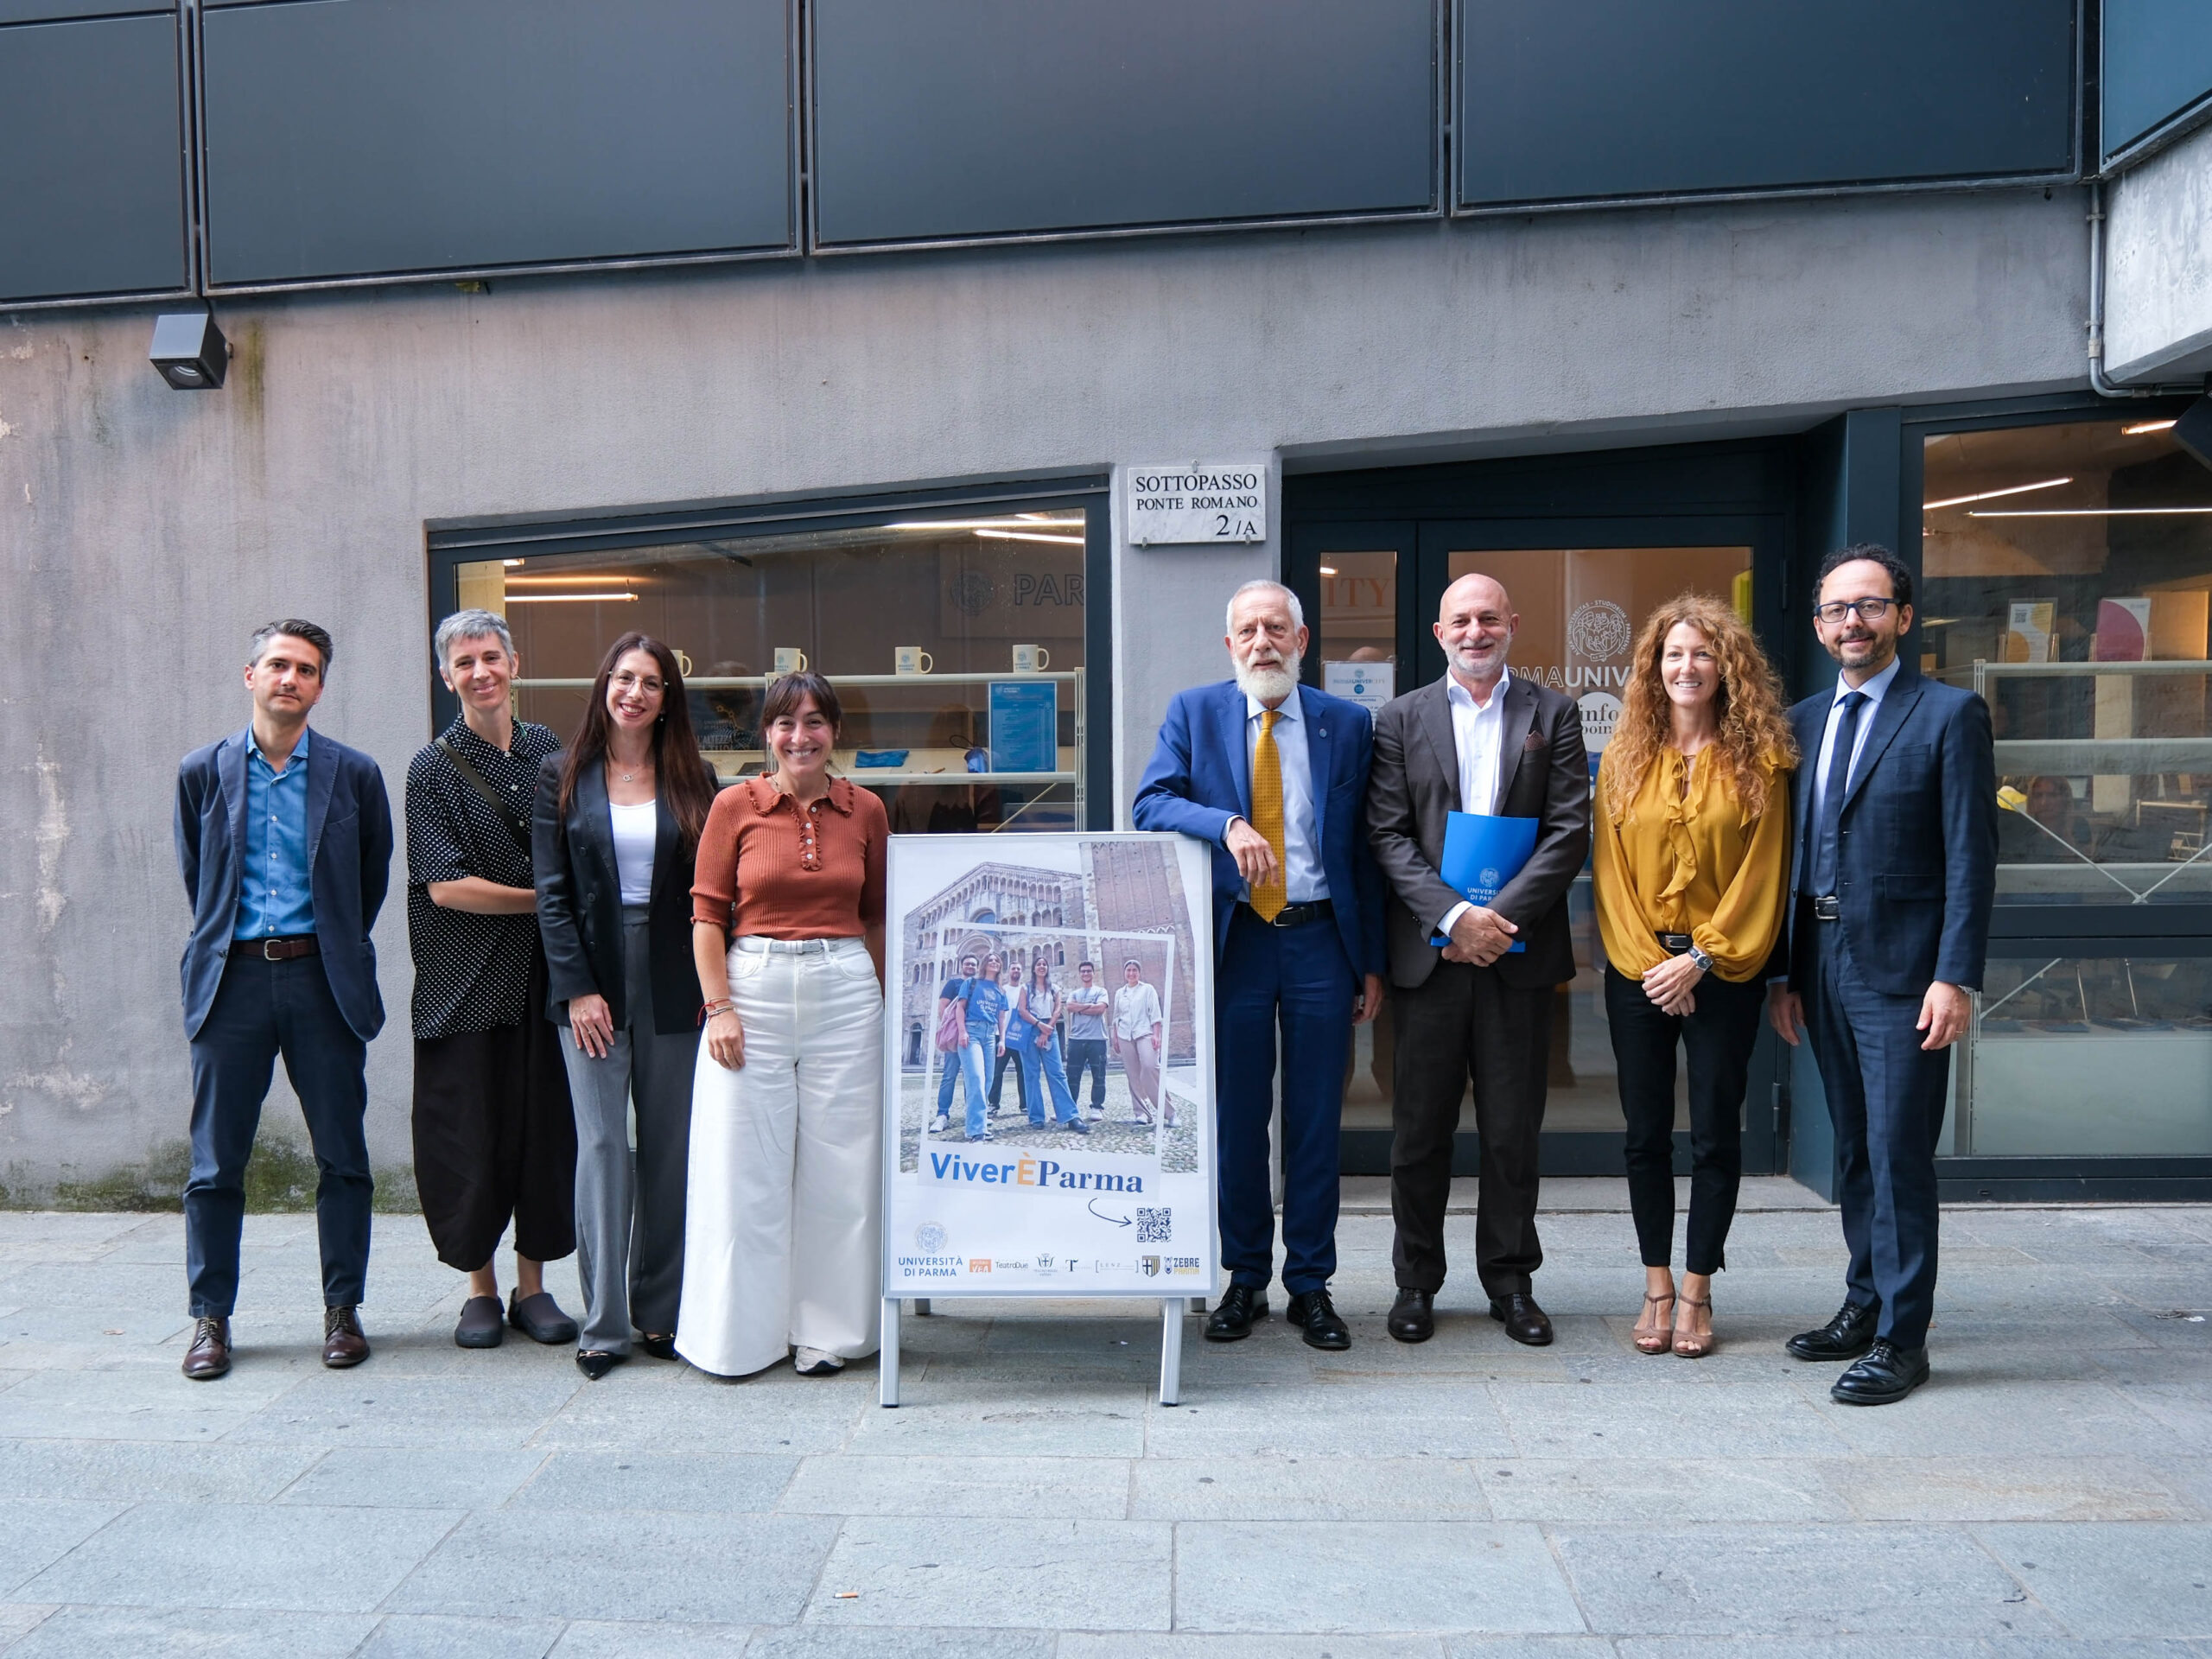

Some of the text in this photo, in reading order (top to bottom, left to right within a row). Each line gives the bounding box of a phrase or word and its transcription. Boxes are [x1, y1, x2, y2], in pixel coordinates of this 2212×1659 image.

[1136, 474, 1257, 492] SOTTOPASSO
[1136, 496, 1257, 510] PONTE ROMANO
[1579, 703, 1619, 721] info
[898, 1255, 963, 1266] UNIVERSITÀ
[1173, 1257, 1199, 1268] ZEBRE
[904, 1268, 957, 1277] DI PARMA
